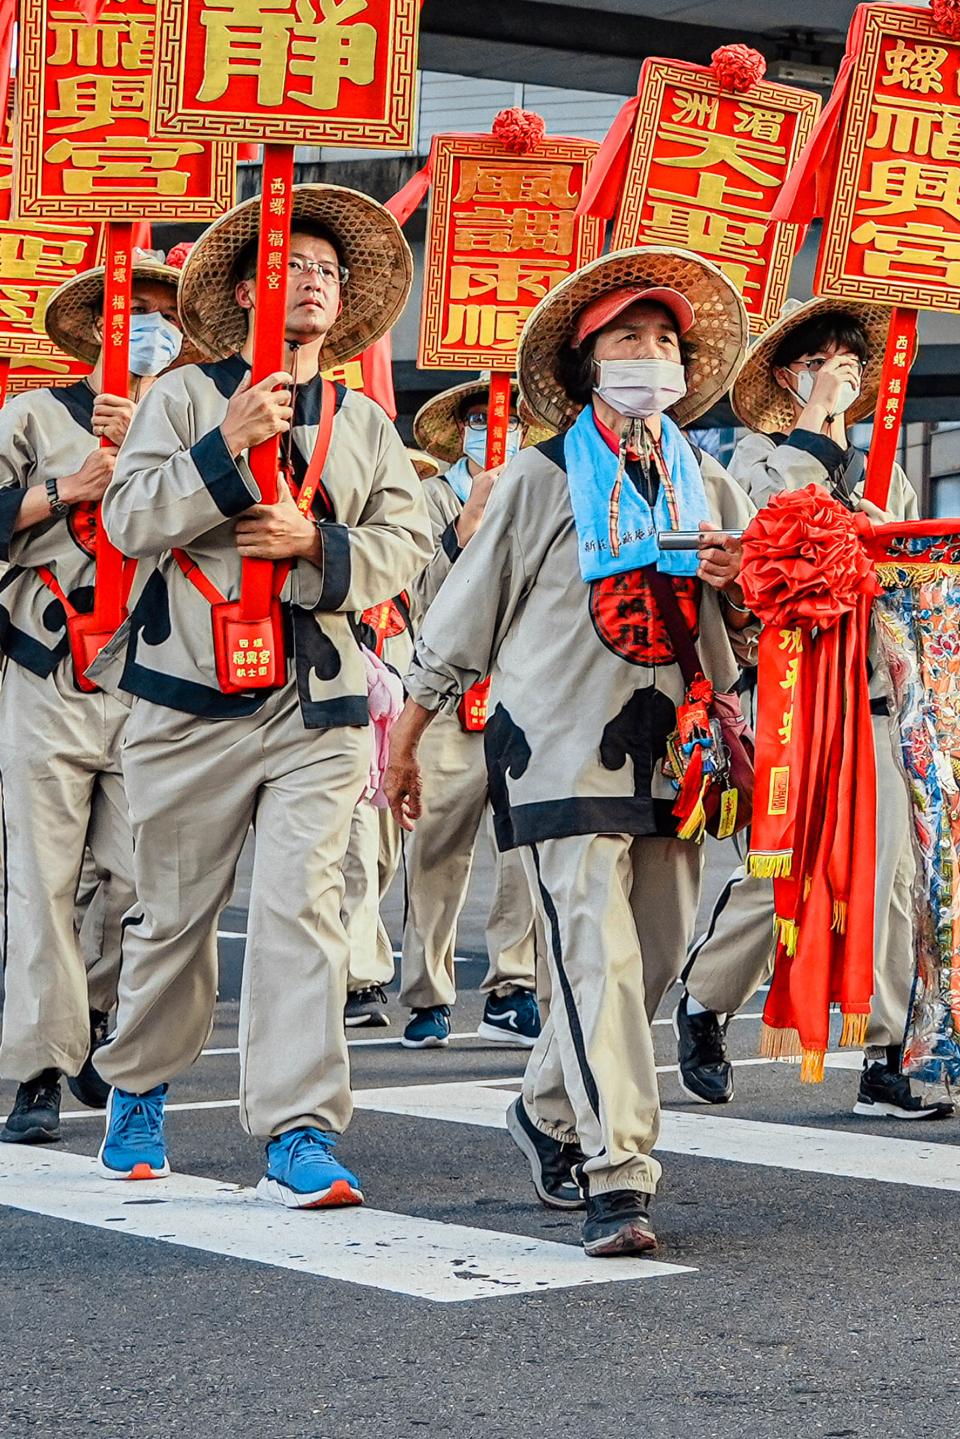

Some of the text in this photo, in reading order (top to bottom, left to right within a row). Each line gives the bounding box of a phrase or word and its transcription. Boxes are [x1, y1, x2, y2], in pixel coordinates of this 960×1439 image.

[671, 90, 784, 143] 湄洲
[266, 177, 286, 290] 西螺 福興宮
[442, 159, 579, 350] 風調雨順
[638, 121, 786, 304] 天上聖
[883, 378, 901, 430] 福興宮
